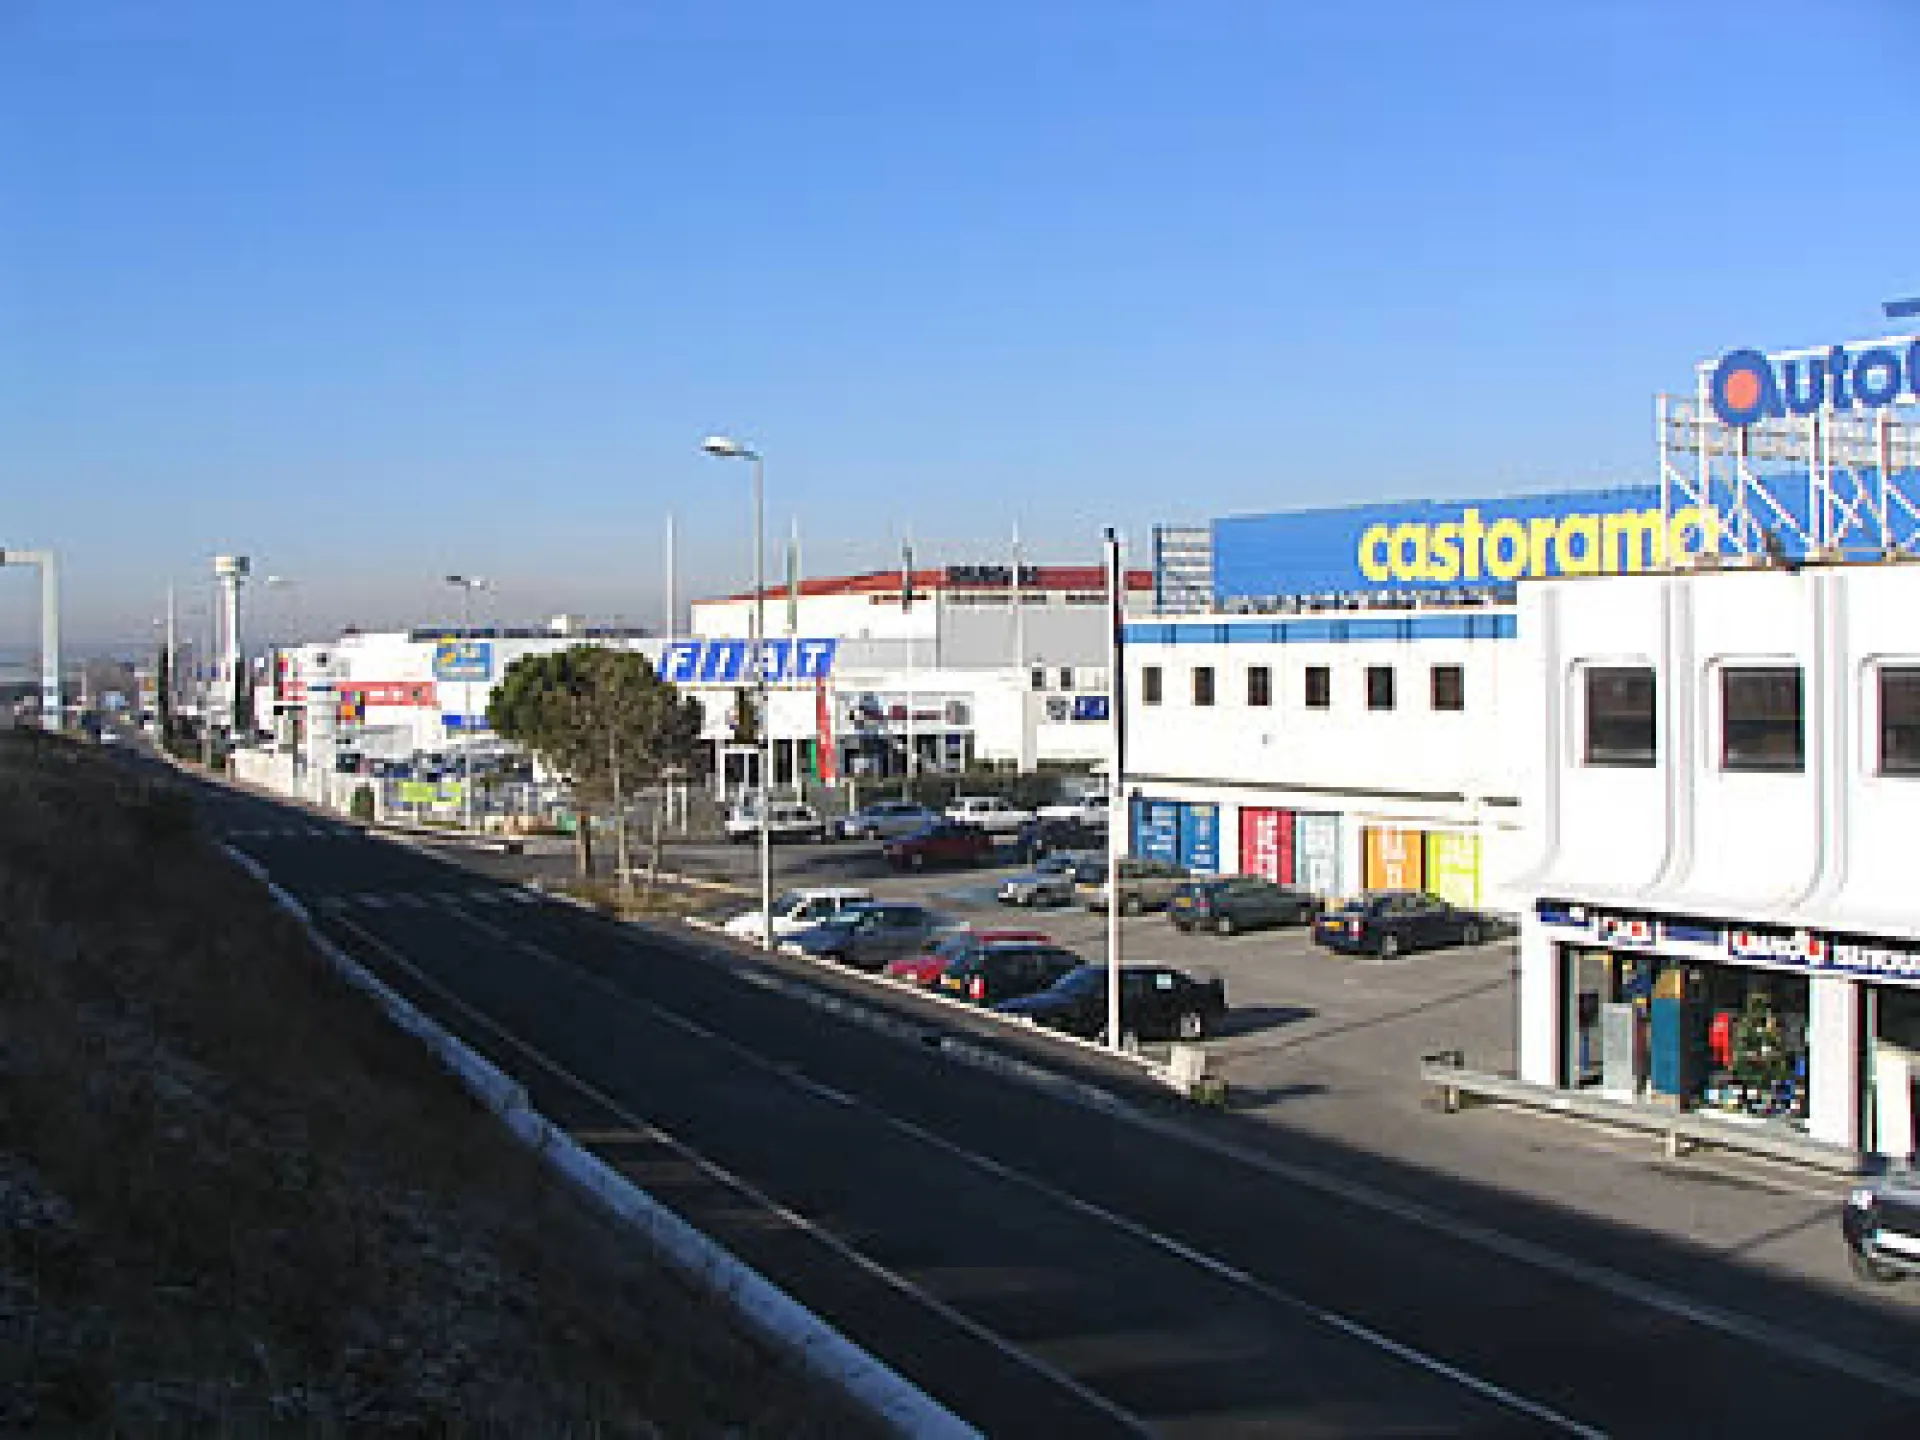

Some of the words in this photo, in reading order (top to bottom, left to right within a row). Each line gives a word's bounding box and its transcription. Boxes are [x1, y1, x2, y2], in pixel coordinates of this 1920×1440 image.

[1713, 341, 1920, 427] Auto
[1358, 508, 1719, 582] castorama
[663, 642, 834, 680] FIAT
